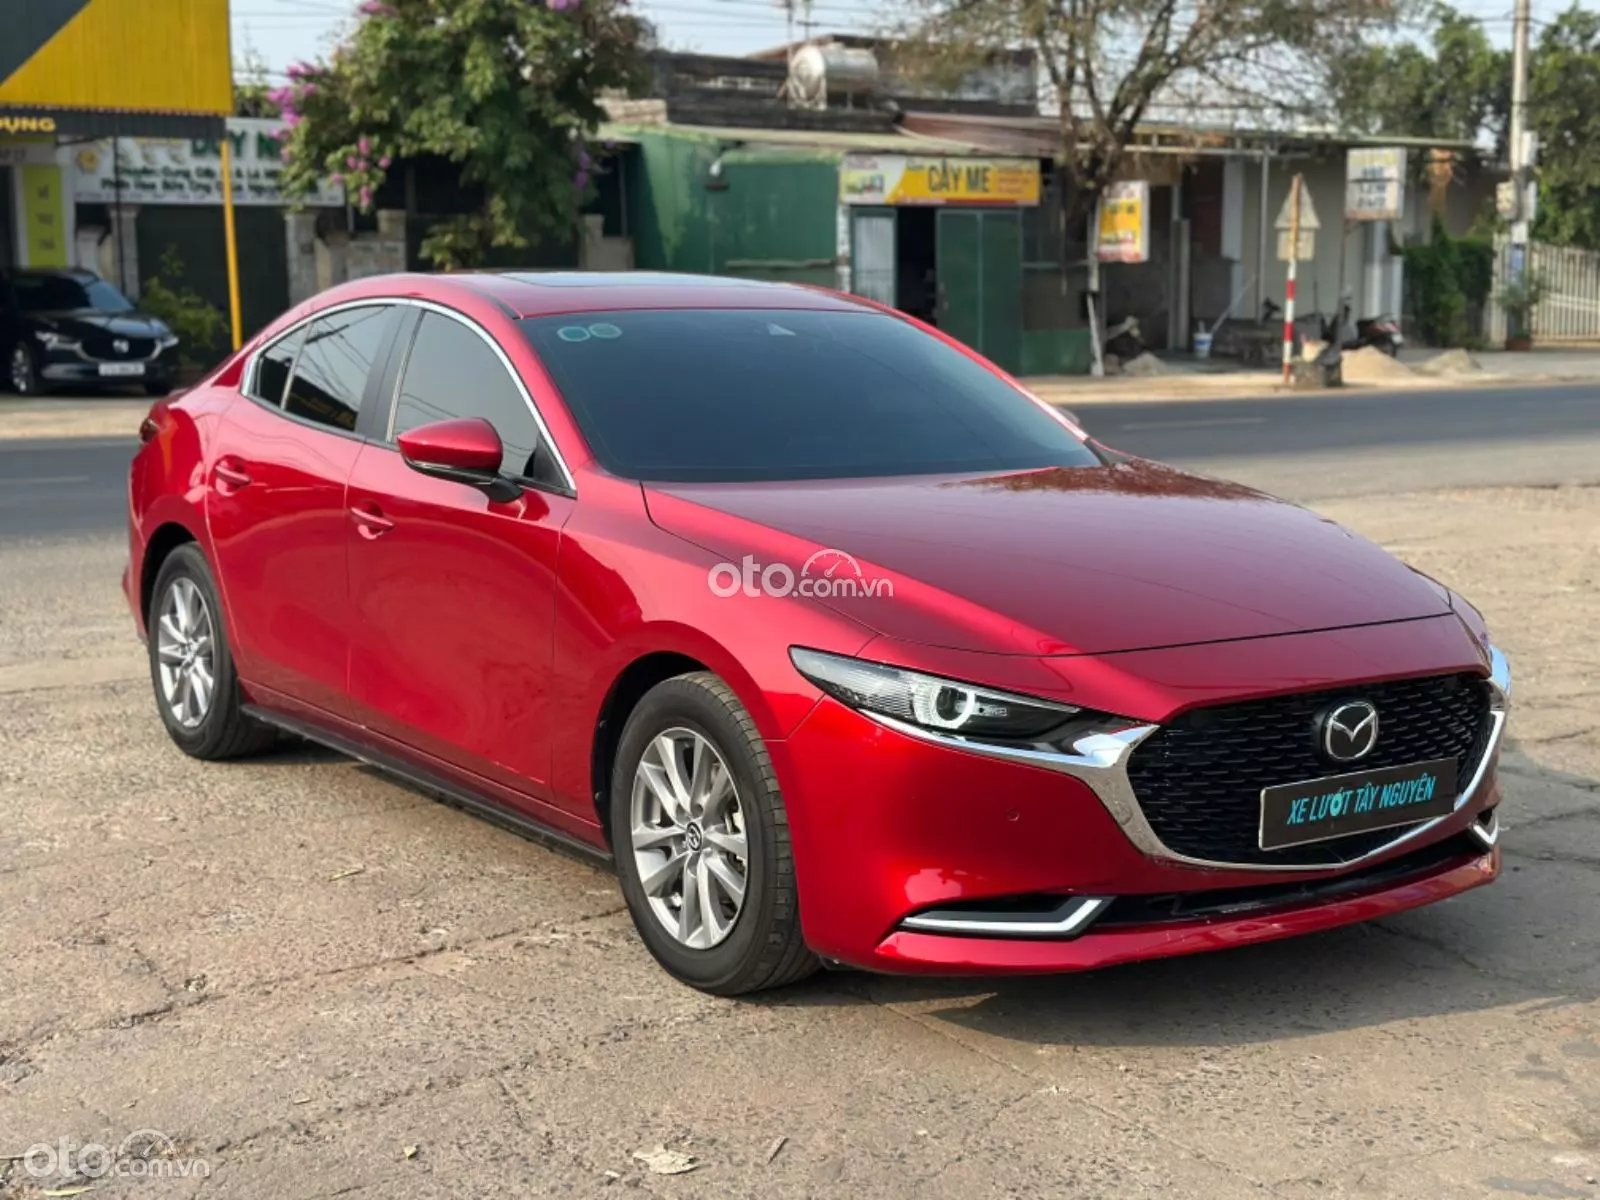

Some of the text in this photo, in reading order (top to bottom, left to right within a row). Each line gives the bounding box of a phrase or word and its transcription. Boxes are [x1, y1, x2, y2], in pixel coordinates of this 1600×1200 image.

[1286, 772, 1436, 825] XE LƯỚT TÂY NGUYÊN
